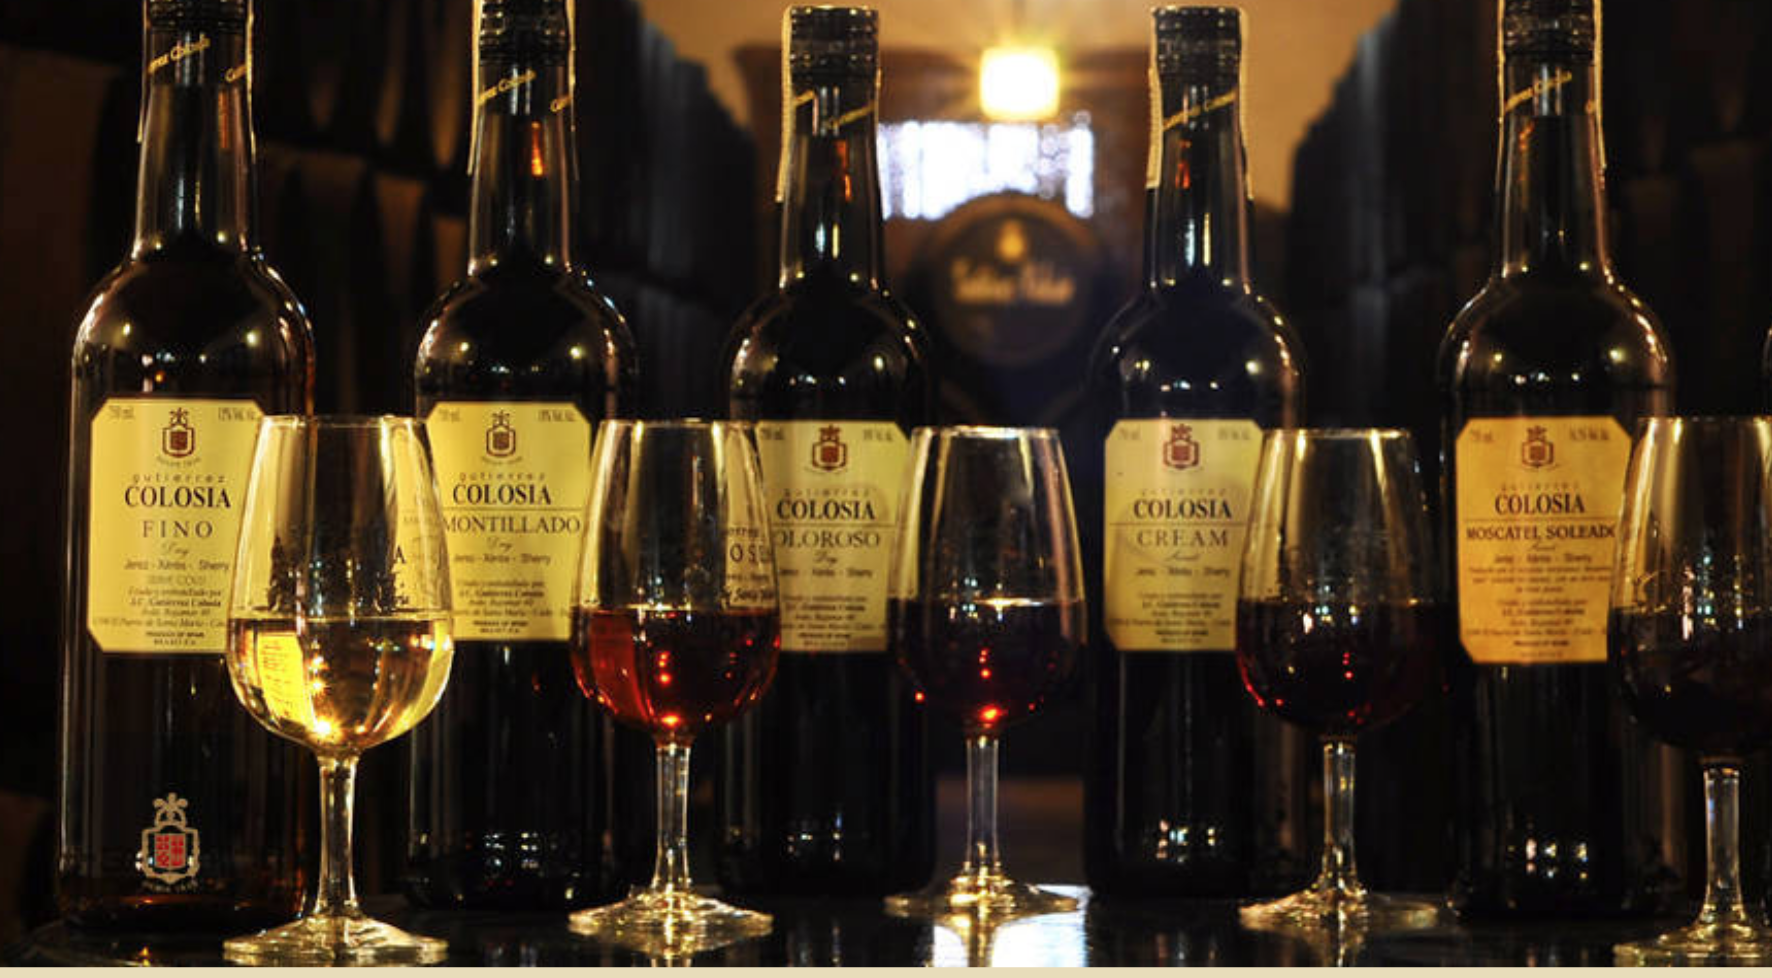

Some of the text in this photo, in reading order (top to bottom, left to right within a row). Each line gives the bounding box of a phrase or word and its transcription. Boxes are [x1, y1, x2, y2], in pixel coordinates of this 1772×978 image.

[125, 486, 232, 508] COLOSIA
[453, 484, 553, 505] COLOSIA
[1494, 493, 1586, 515] COLOSIA
[776, 500, 876, 521] COLOSIA
[1133, 498, 1233, 520] COLOSIA
[143, 521, 214, 538] FINO
[443, 516, 580, 534] MONTILLADO
[1467, 526, 1539, 541] MOSCATEL
[1136, 529, 1229, 548] CREAM
